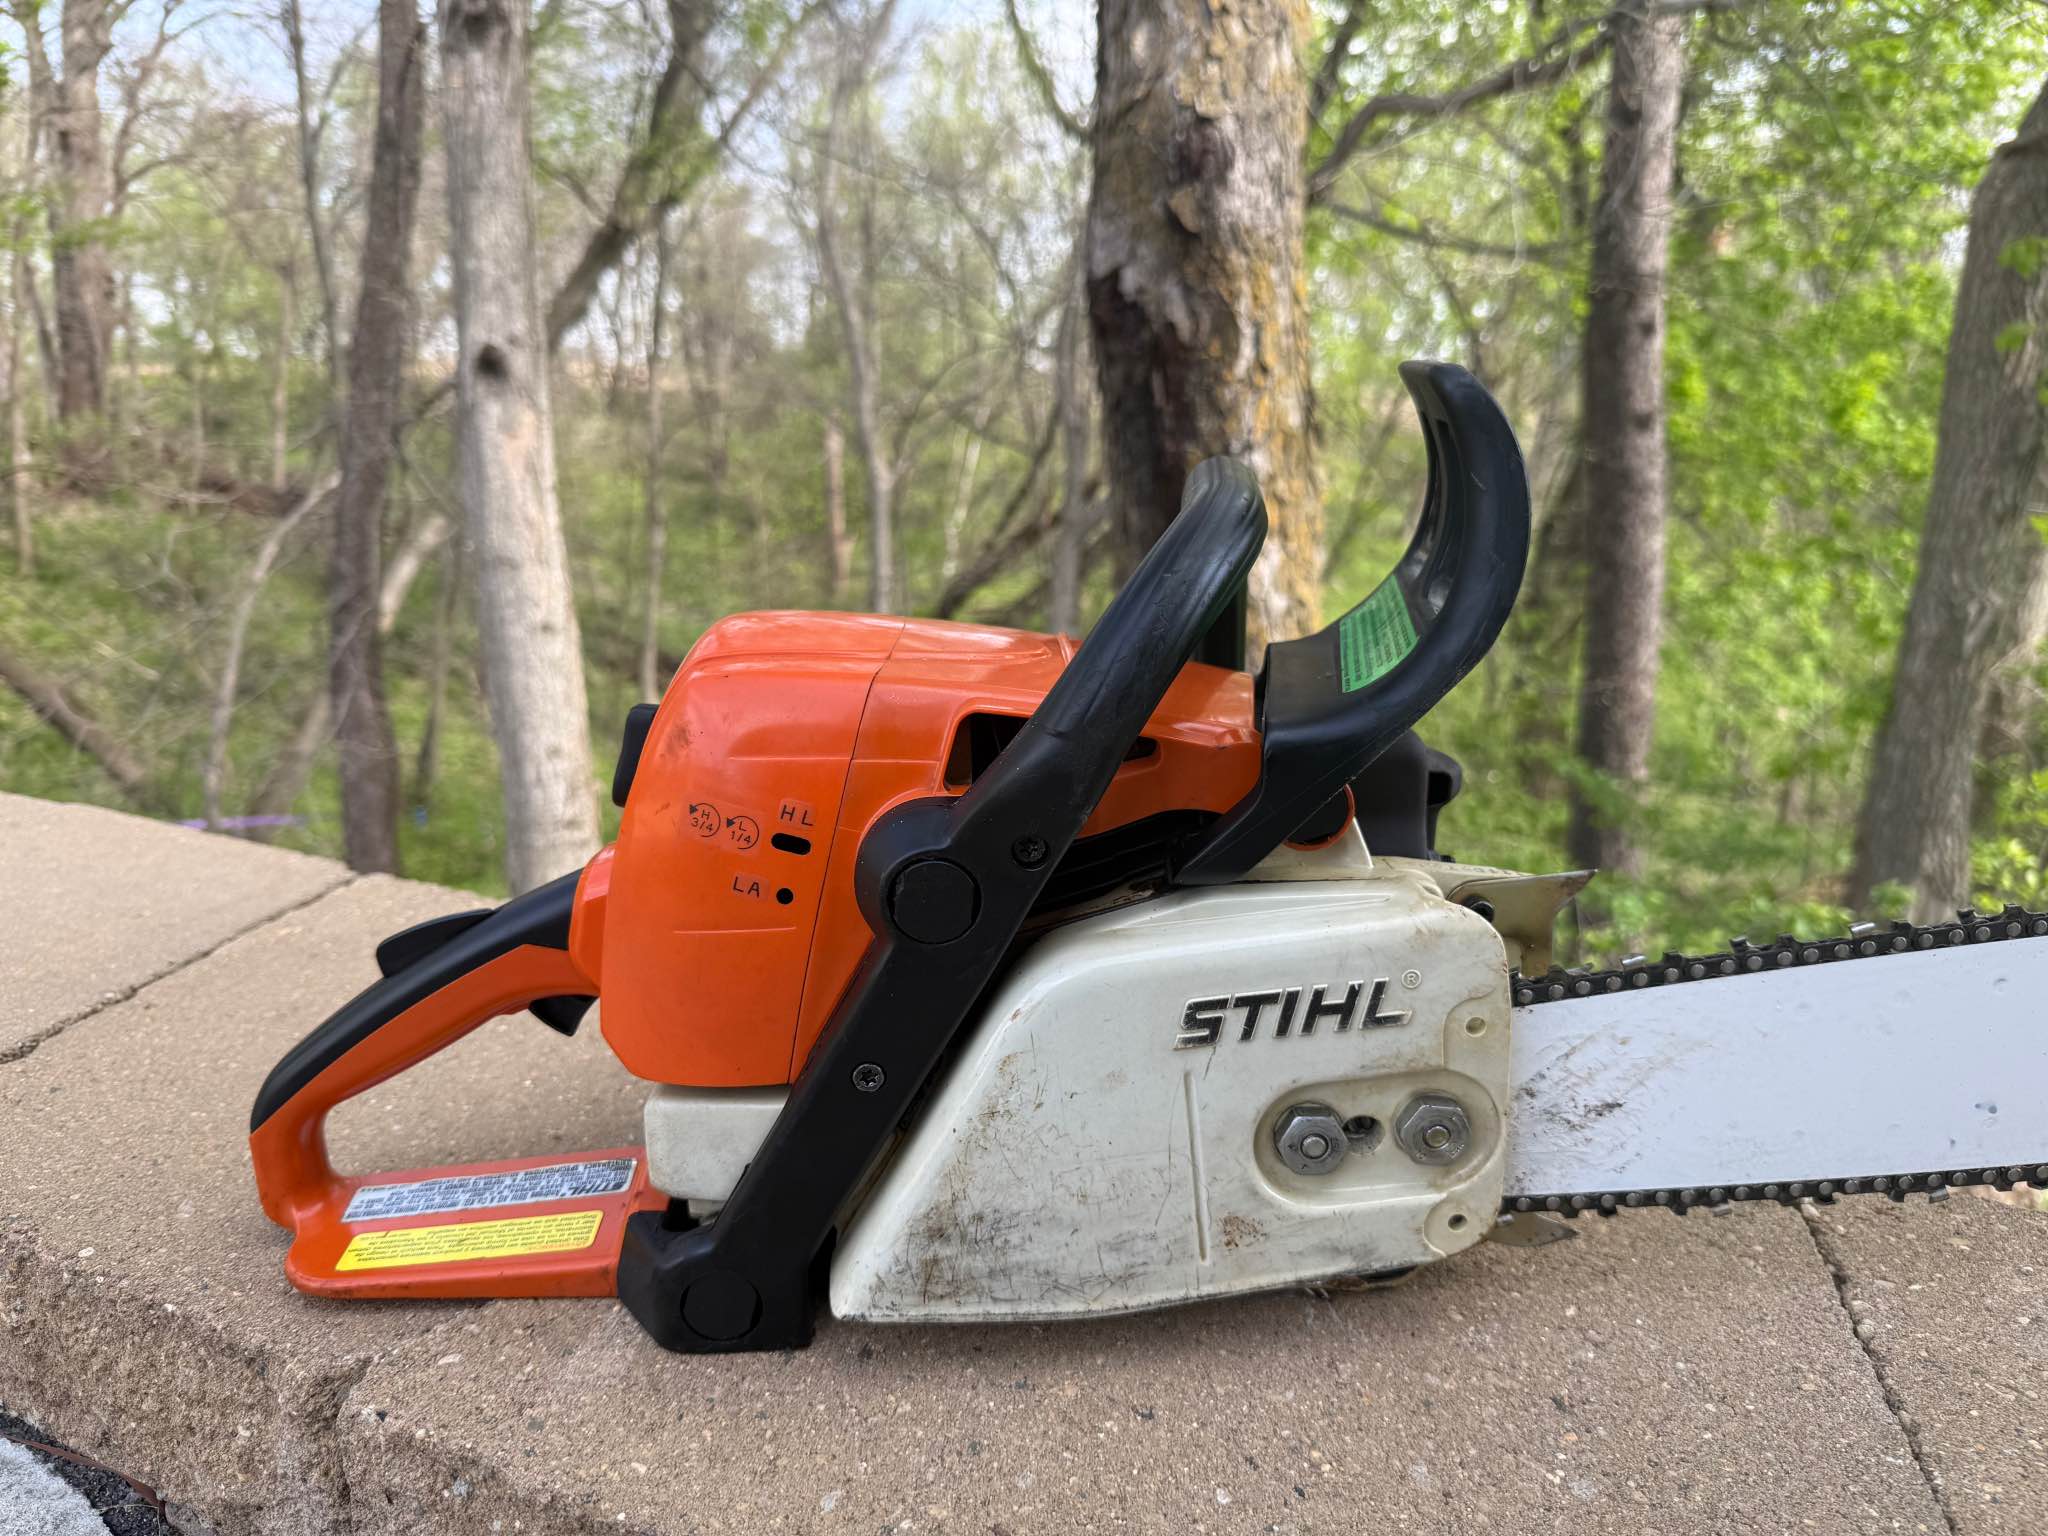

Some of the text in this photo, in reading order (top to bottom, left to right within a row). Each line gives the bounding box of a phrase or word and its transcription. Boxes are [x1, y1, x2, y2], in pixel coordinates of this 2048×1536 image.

[701, 809, 710, 820] H
[691, 817, 713, 832] 3/4
[738, 821, 747, 832] L
[730, 831, 752, 844] 1/4
[1173, 977, 1413, 1051] STIHL
